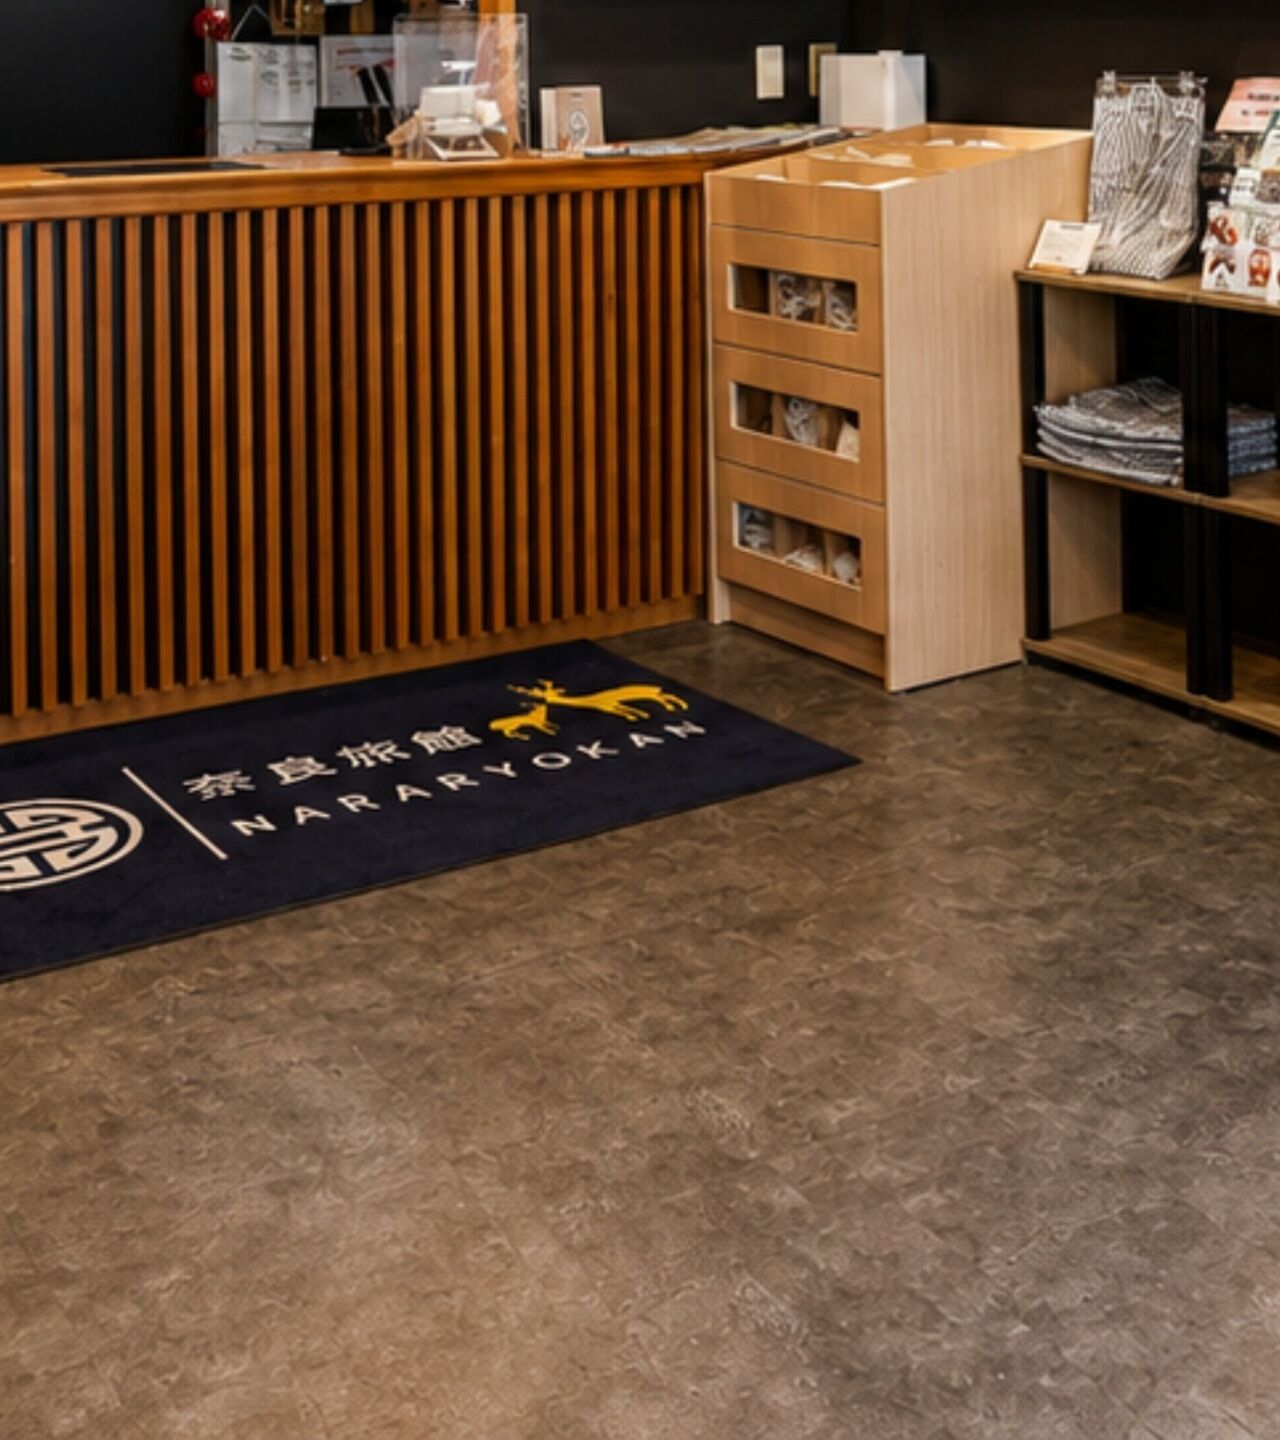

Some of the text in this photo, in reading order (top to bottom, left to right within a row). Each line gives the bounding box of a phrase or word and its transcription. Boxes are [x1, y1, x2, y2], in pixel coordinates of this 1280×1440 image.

[182, 724, 483, 801] 奈良旅館
[230, 719, 706, 837] NARARYOKAN
